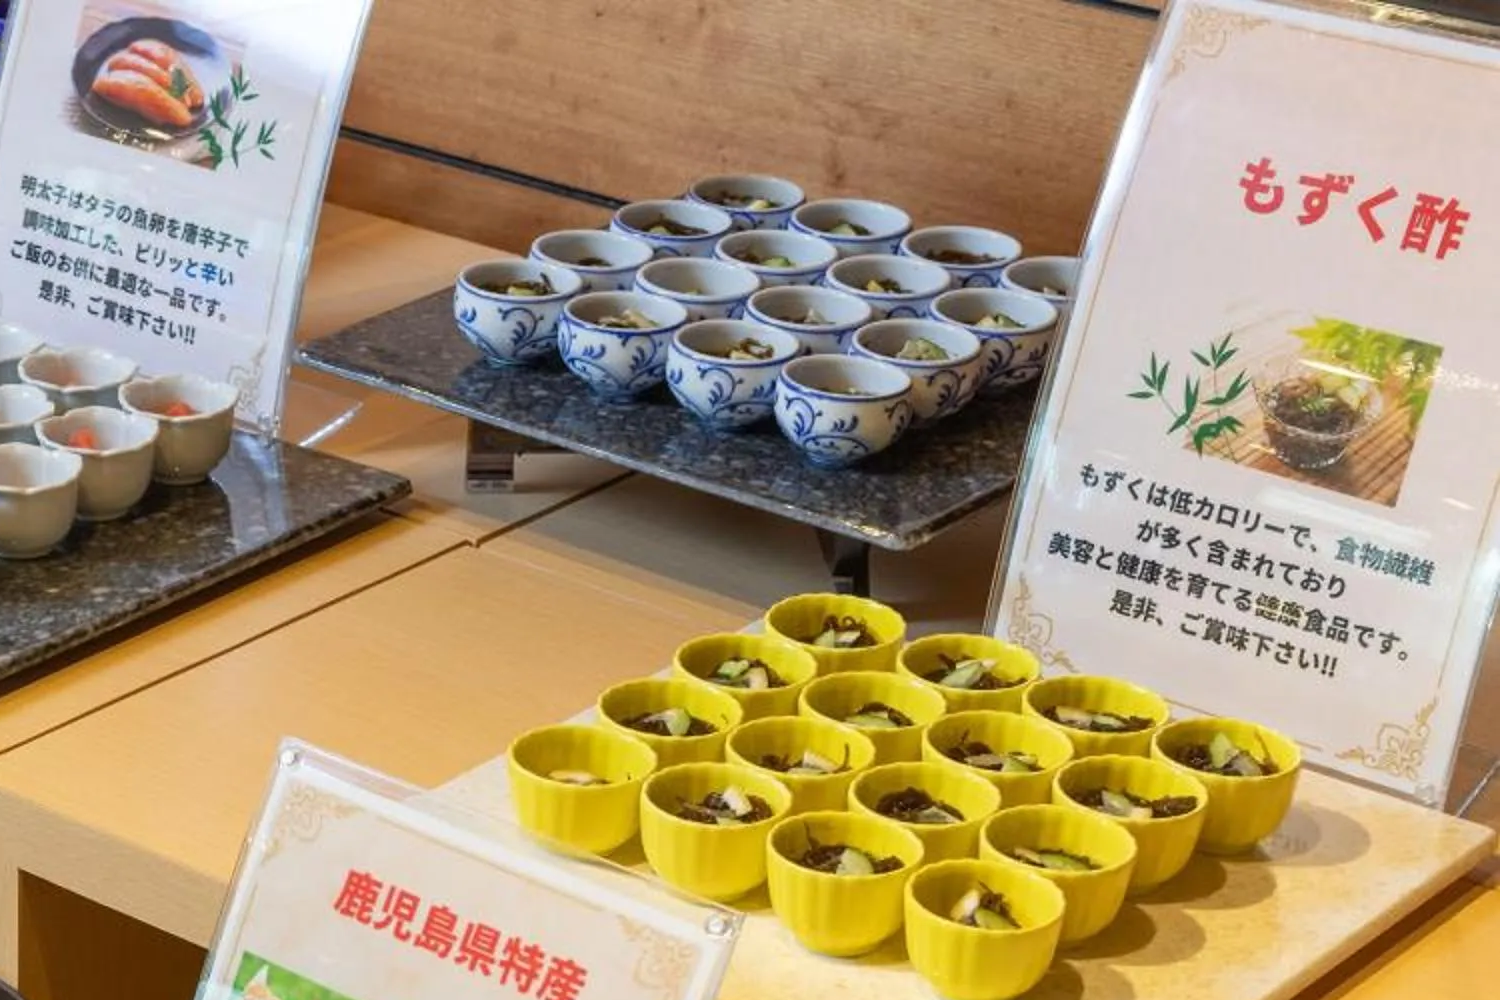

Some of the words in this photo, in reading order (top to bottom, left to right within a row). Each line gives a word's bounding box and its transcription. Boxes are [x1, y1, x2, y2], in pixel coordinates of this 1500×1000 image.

[20, 174, 250, 259] 明太子はタラの魚卵を唐辛子で
[1239, 157, 1471, 260] もずく酢
[10, 239, 227, 323] ご飯のお供に最適な一品です。
[1080, 463, 1436, 587] もずくは低カロリーで、食物繊維
[1136, 520, 1347, 598] が多く含まれており
[1048, 532, 1410, 662] 美容と健康を育てる健康食品です。
